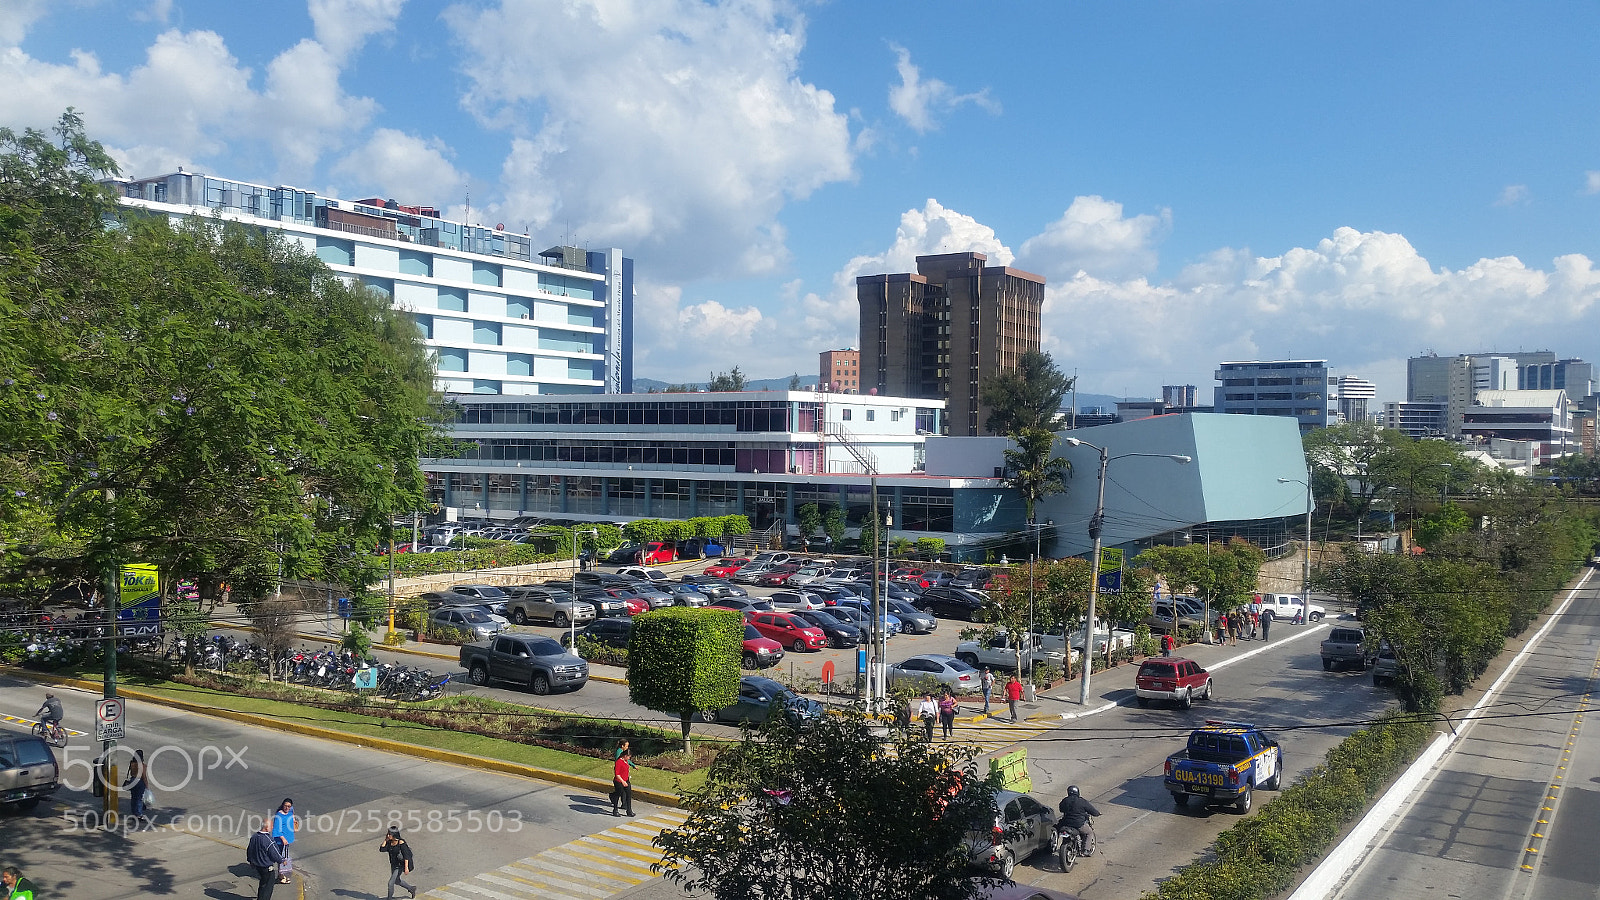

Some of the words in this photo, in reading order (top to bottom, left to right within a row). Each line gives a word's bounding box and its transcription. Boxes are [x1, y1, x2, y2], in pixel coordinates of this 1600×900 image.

[105, 704, 116, 718] E
[98, 727, 123, 735] CARGA
[1175, 769, 1224, 786] GUA-13198
